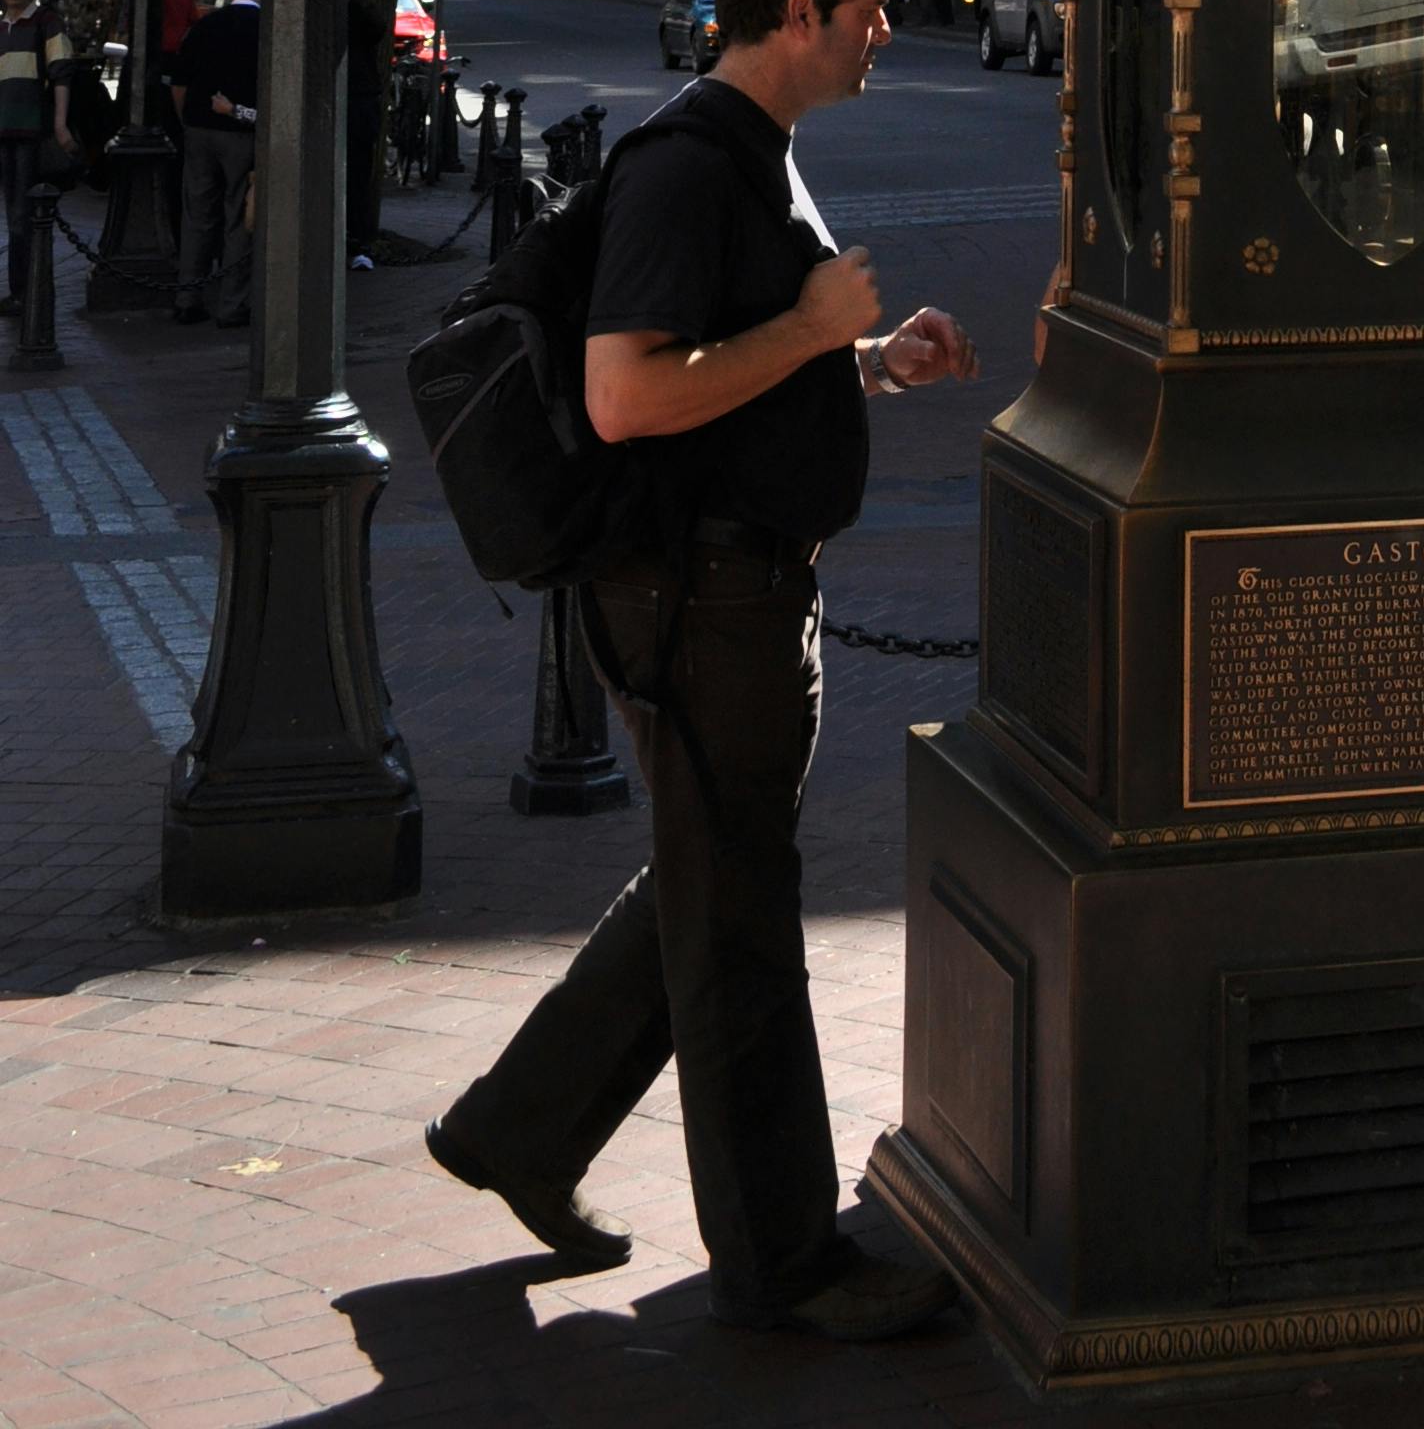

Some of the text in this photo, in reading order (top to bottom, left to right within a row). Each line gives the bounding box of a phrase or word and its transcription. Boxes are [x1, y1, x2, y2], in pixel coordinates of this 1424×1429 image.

[1239, 566, 1282, 590] THIS
[1289, 576, 1334, 587] CLOCK
[1357, 571, 1418, 583] LOCATED
[1233, 594, 1259, 604] THE
[1267, 592, 1294, 602] OLD
[1303, 586, 1383, 600] GRANVILLE
[1271, 606, 1296, 616] THE
[1303, 602, 1348, 614] SHORE
[1210, 622, 1256, 633] YARDS
[1264, 618, 1311, 630] NORTH
[1340, 615, 1369, 625] THIS
[1211, 634, 1278, 647] GASTOWN
[1288, 631, 1315, 642] WAS
[1321, 629, 1344, 640] THE
[1232, 648, 1258, 658] THE
[1328, 642, 1356, 652] HAD
[1363, 638, 1415, 650] BECOME
[1321, 657, 1343, 666] THE
[1350, 654, 1389, 664] EARLY
[1211, 677, 1230, 687] ITS
[1238, 673, 1295, 686] FORMER
[1210, 690, 1239, 701] WAS
[1248, 688, 1274, 698] DUE
[1306, 681, 1376, 694] PROPERTY
[1210, 702, 1264, 715] PEOPLE
[1298, 695, 1367, 709] GASTOWN
[1209, 715, 1276, 728] COUNCIL
[1288, 712, 1318, 723] AND
[1332, 708, 1373, 720] CIVIC
[1307, 721, 1382, 735] COMPOSED
[1290, 738, 1328, 749] WERE
[1232, 757, 1256, 768] THE
[1332, 749, 1369, 760] JOHN
[1243, 766, 1327, 781] COMMITTEE
[1335, 761, 1400, 774] BETWEEN
